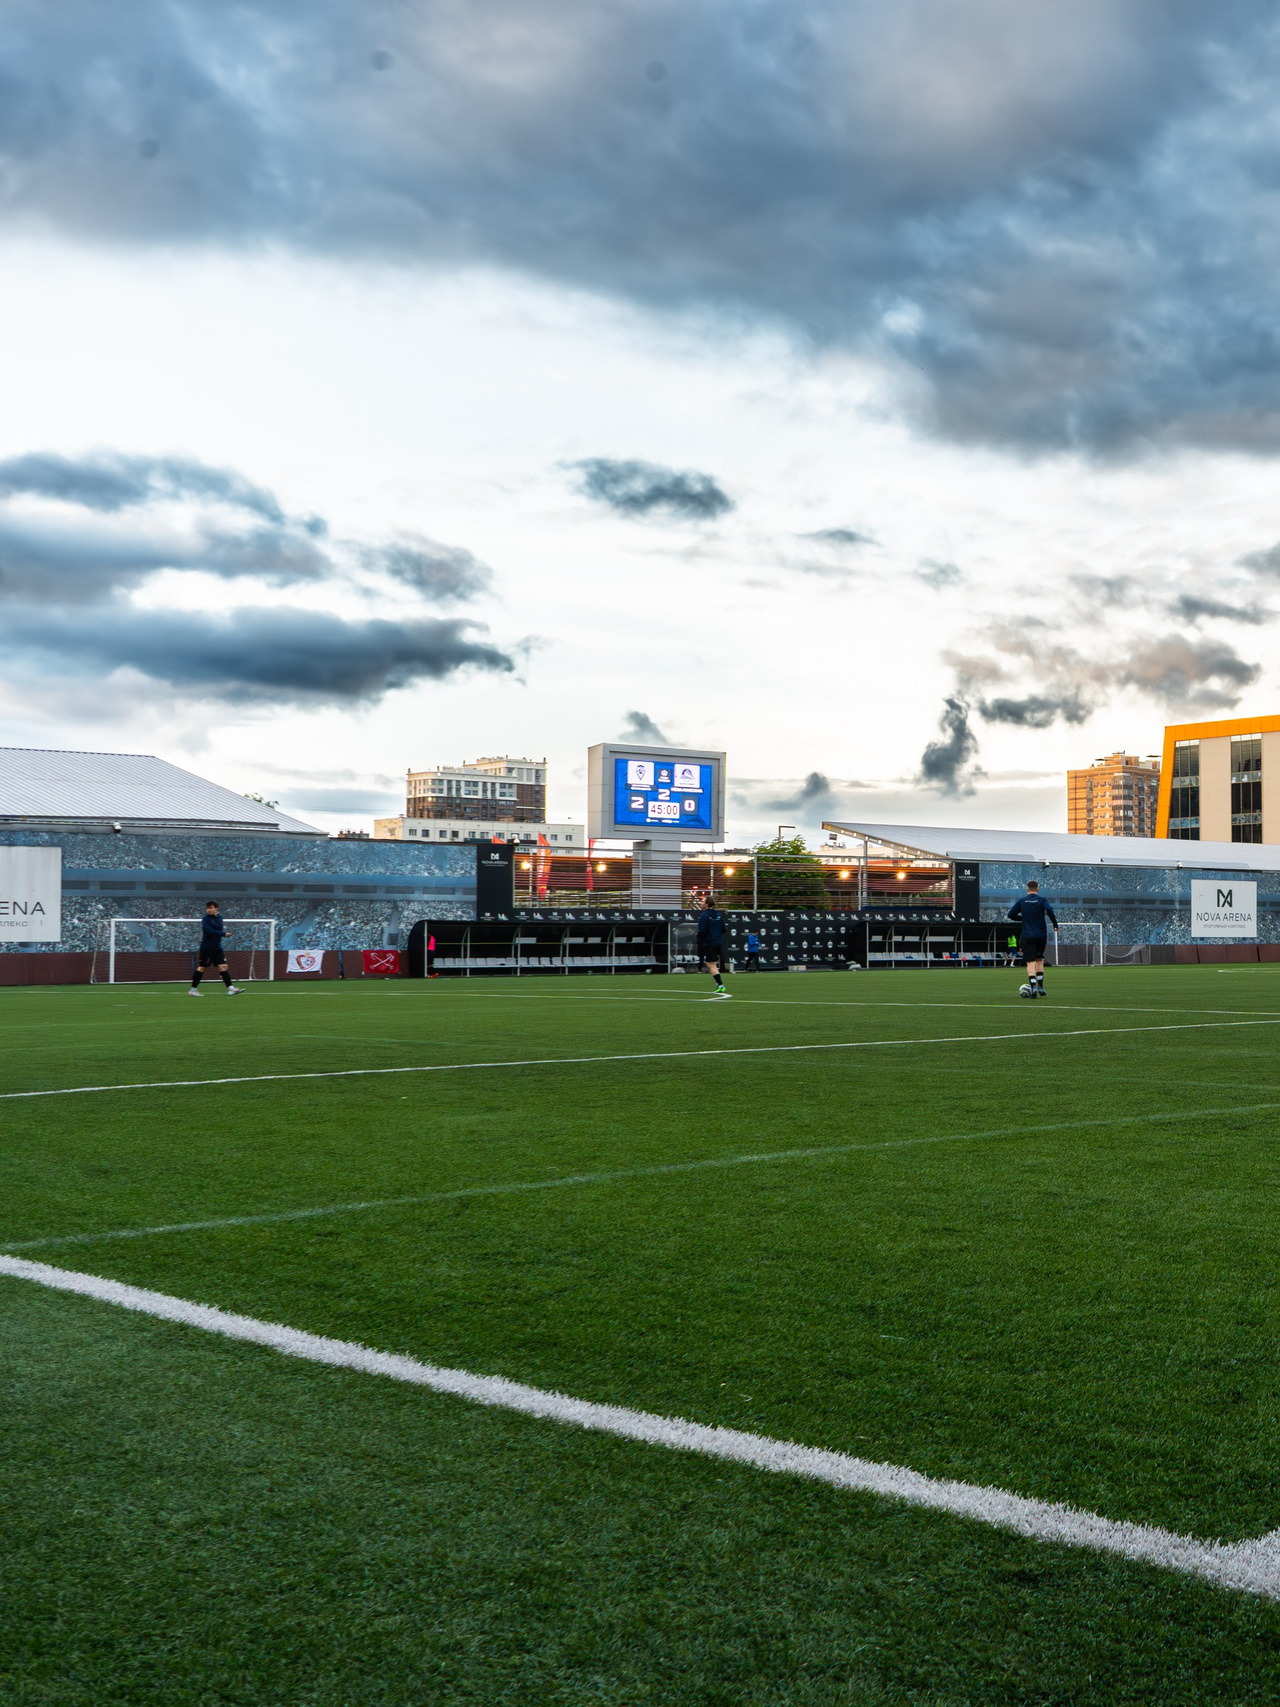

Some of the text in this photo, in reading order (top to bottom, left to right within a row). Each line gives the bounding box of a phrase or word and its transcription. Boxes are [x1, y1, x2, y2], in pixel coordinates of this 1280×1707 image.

[631, 796, 644, 809] 2
[650, 803, 678, 816] 45:00
[1196, 912, 1252, 922] NOVA ARENA
